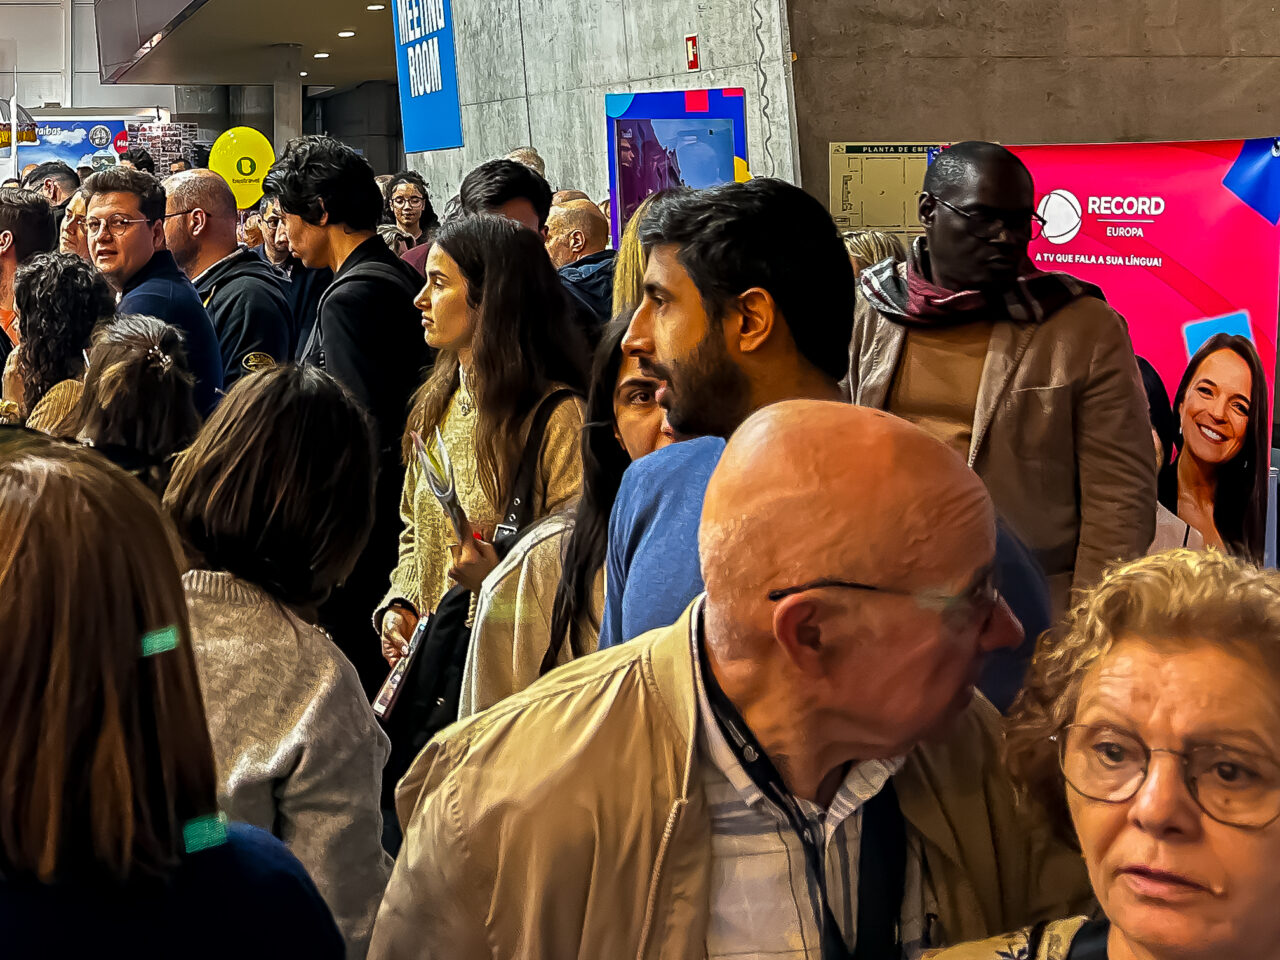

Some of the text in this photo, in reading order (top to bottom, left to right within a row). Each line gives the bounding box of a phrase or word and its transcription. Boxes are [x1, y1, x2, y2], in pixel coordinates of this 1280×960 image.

[407, 36, 442, 98] ROOM
[1087, 196, 1166, 216] RECORD
[1106, 226, 1144, 238] EUROPA
[1035, 253, 1162, 267] A TV QUE FALA A SUA LÍNGUA!
